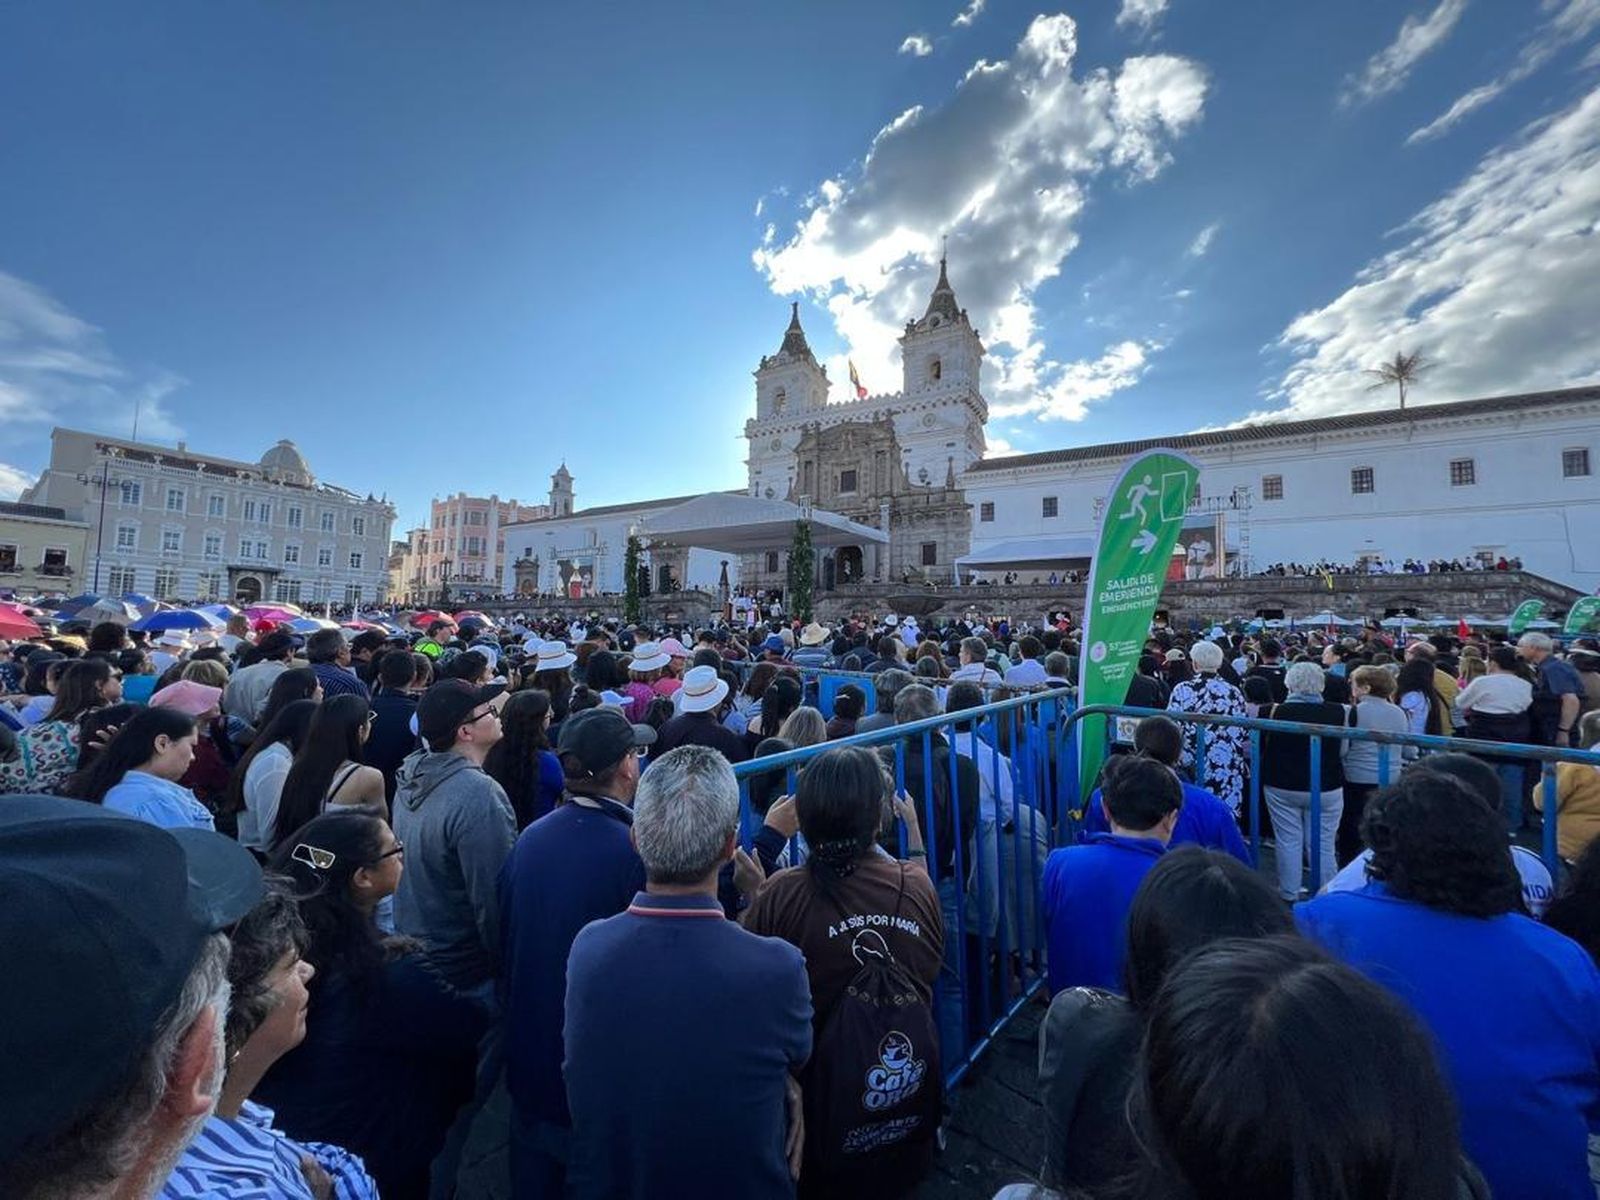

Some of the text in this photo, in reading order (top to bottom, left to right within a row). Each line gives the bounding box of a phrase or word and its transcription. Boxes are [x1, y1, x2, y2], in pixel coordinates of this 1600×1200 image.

[1140, 573, 1155, 584] DE
[1099, 585, 1159, 602] EMERENCIA
[828, 925, 838, 938] A
[866, 914, 888, 926] POR
